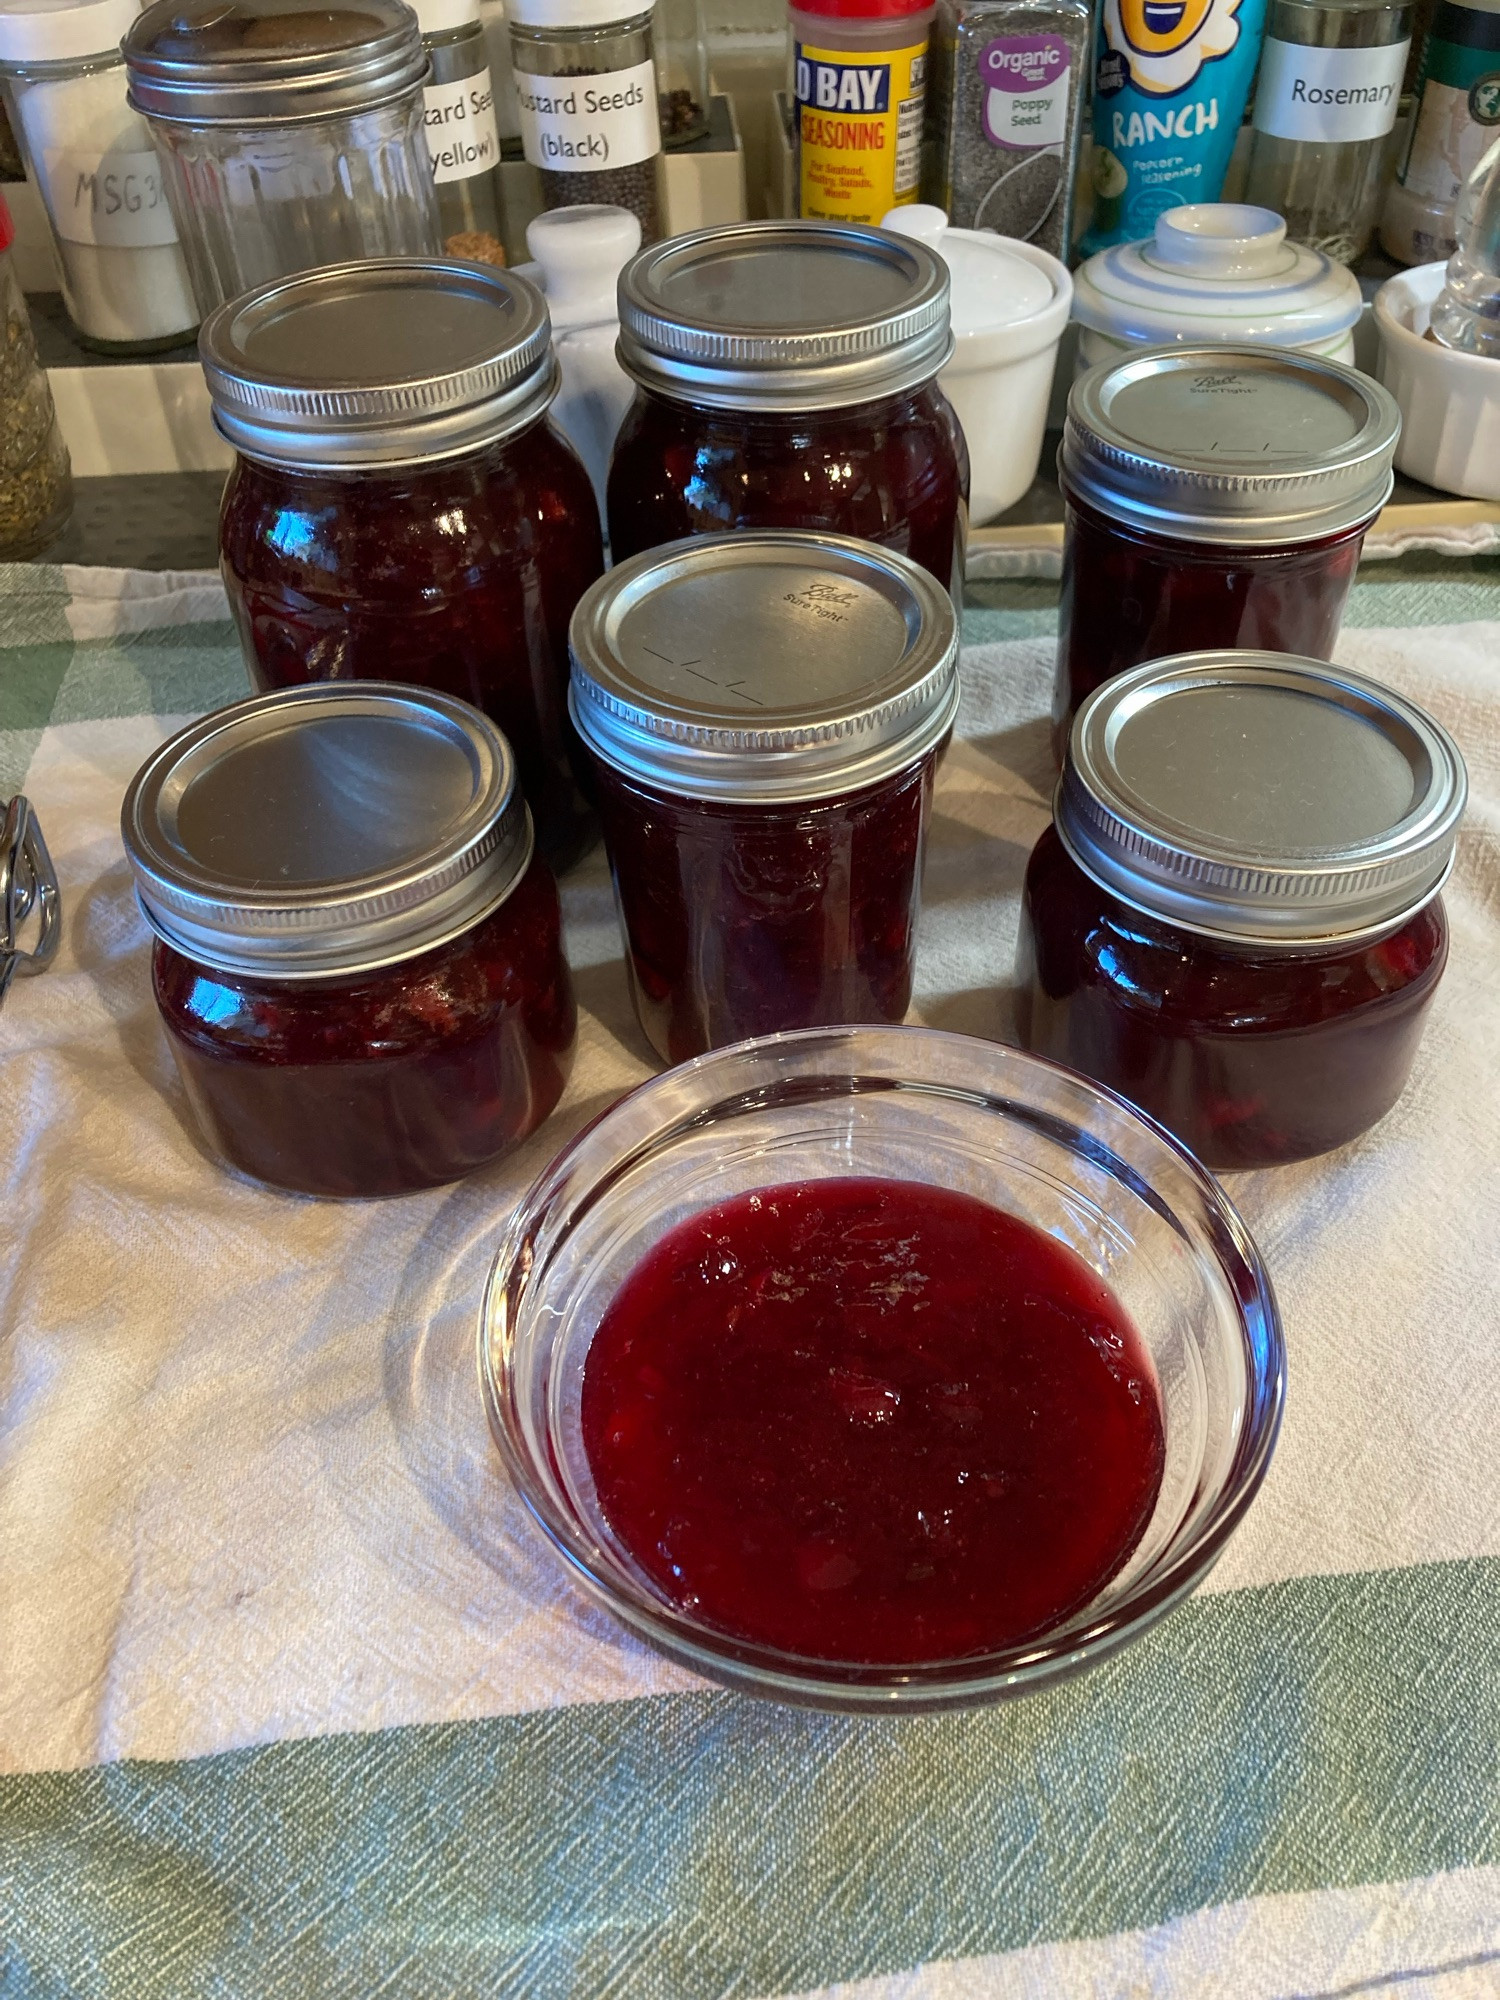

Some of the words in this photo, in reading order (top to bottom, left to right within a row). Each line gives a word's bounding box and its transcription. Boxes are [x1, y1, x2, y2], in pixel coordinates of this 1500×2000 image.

[988, 45, 1060, 73] Organic
[584, 83, 644, 114] Seeds
[816, 66, 883, 111] BAY
[1291, 79, 1396, 106] Rosemary
[1011, 99, 1053, 112] Poppy
[802, 114, 885, 151] SEASONING
[1010, 114, 1042, 127] Seed
[1112, 98, 1219, 149] RANCH
[541, 132, 610, 162] (black)
[1194, 375, 1239, 389] Ball
[800, 583, 859, 608] Ball
